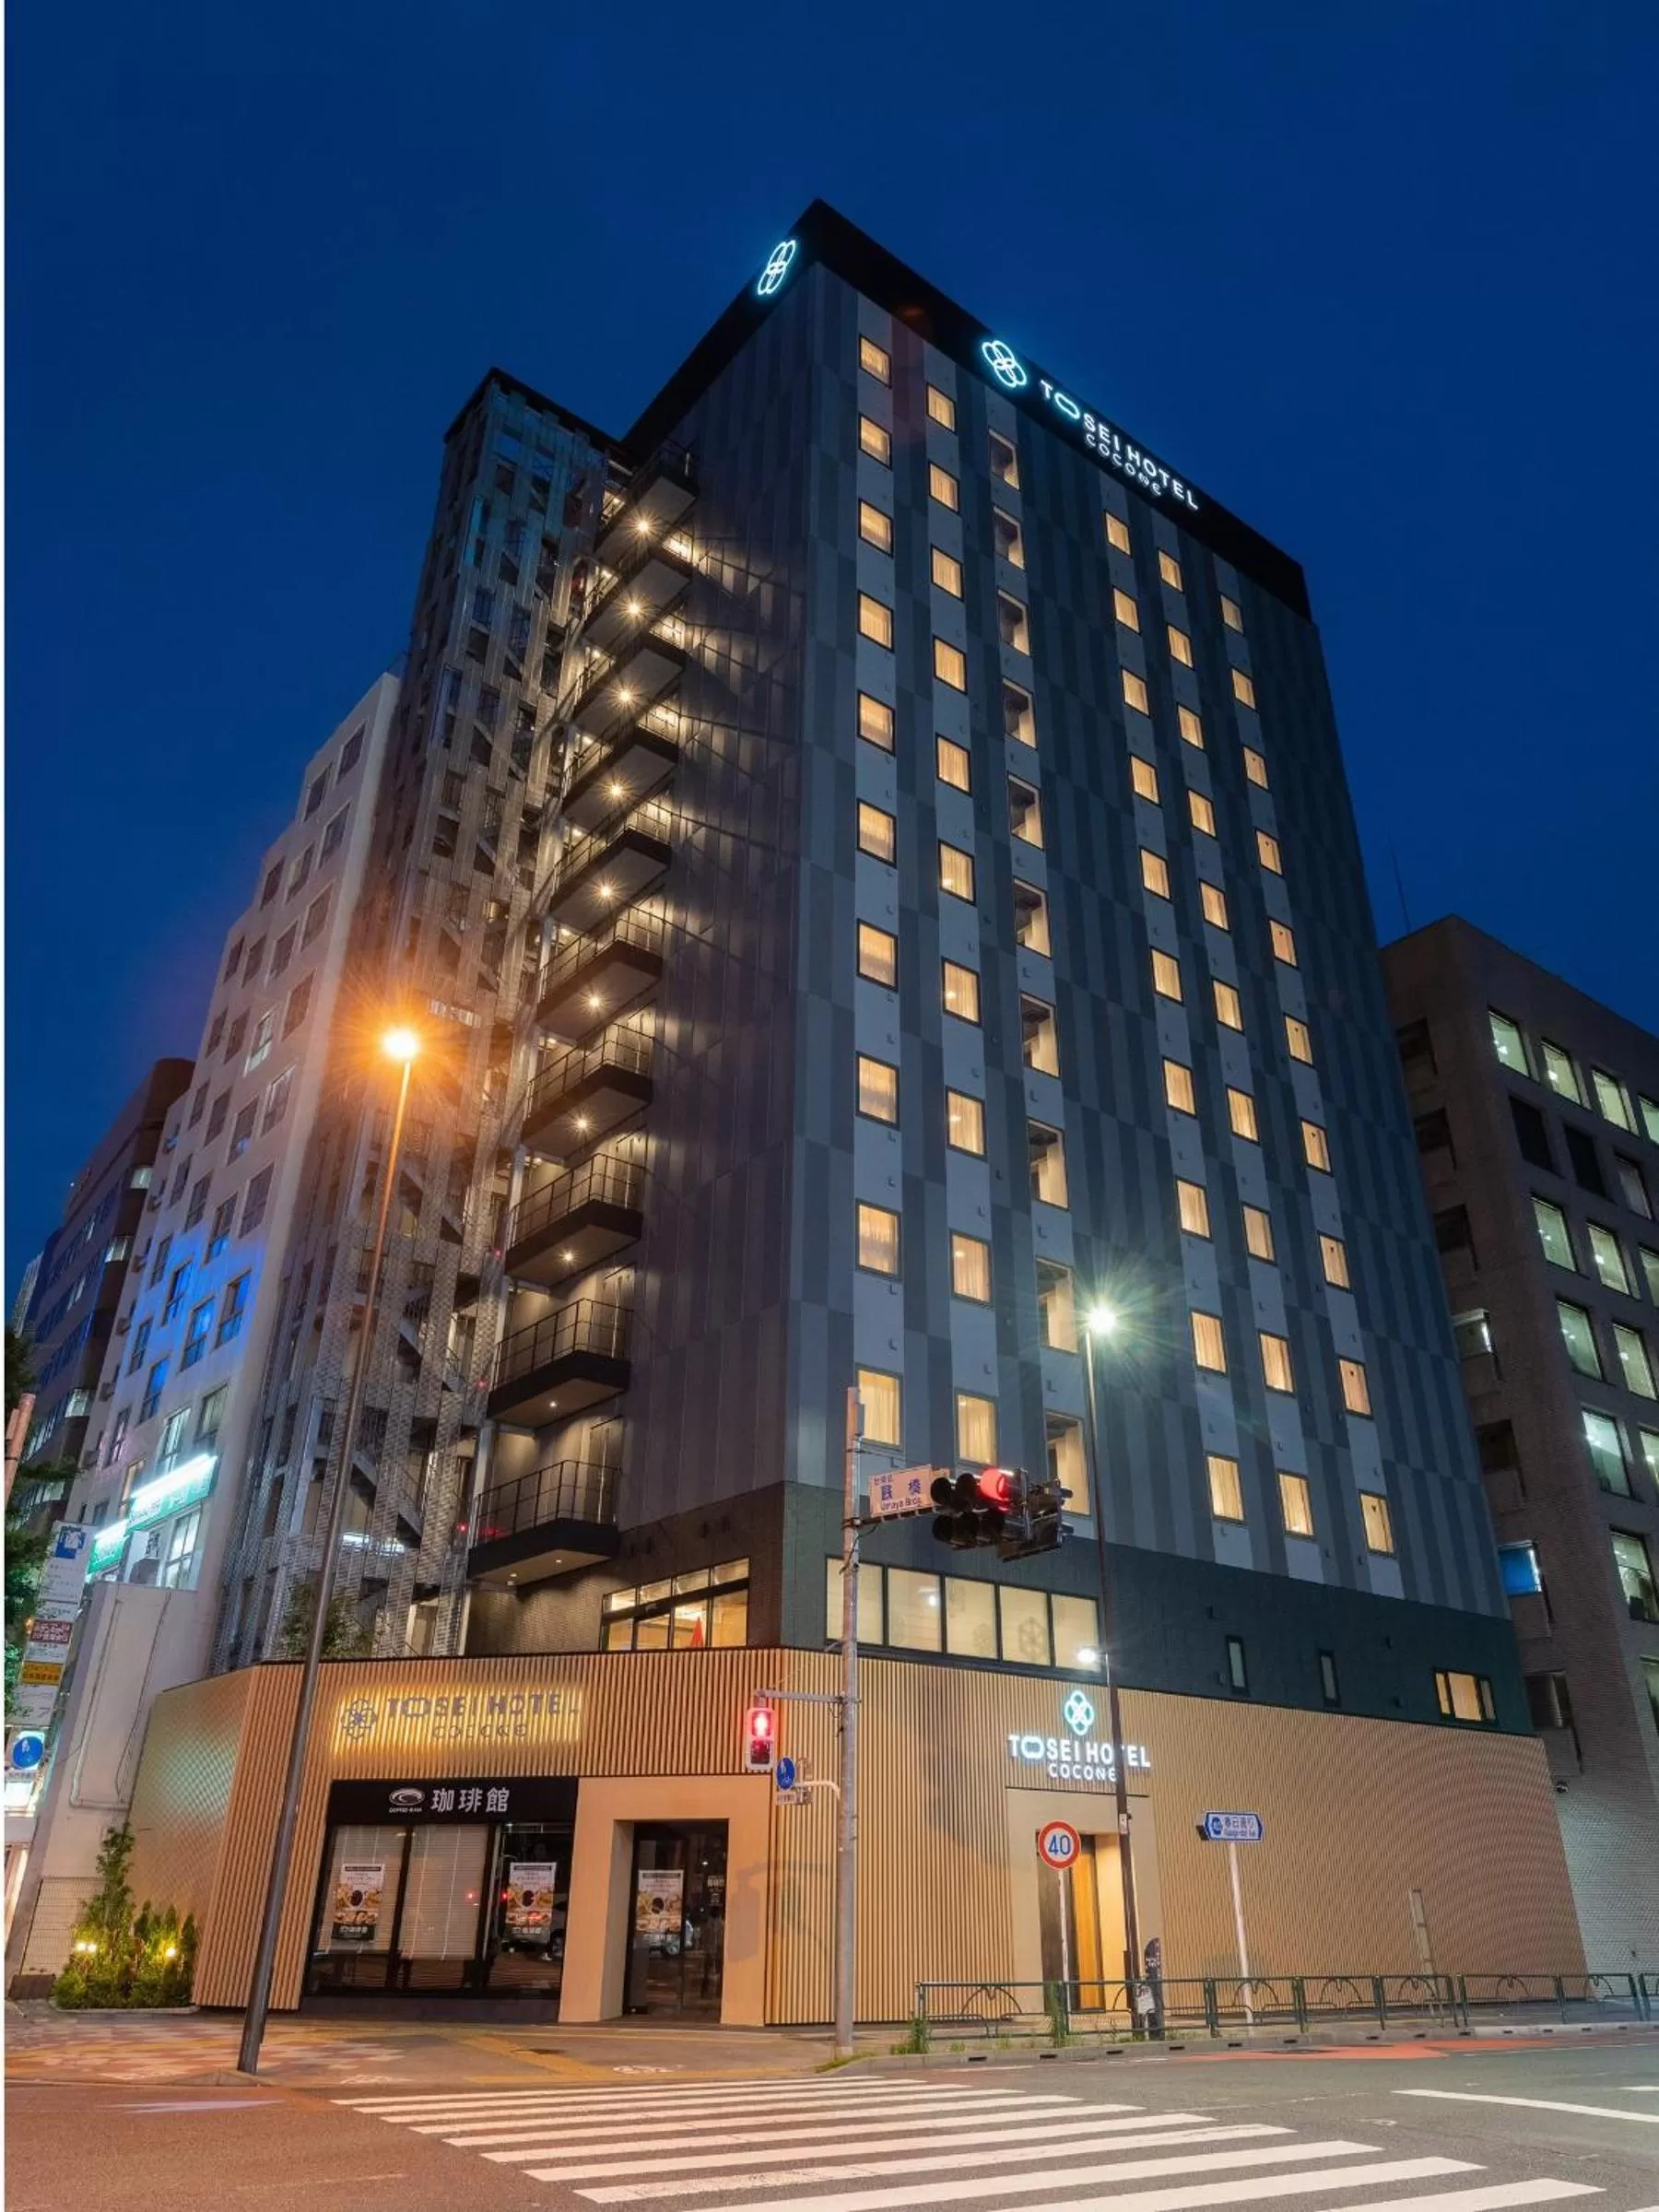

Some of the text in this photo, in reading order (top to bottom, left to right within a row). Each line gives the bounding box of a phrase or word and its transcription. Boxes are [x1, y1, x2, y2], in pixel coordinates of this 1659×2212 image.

[1040, 379, 1198, 511] TOSEI HOTEL
[1086, 434, 1162, 496] COCONE
[387, 1693, 580, 1718] TOSEI HOTEL
[1008, 1734, 1151, 1768] TOSEI HOEL
[1049, 1762, 1117, 1782] COCONE
[430, 1787, 510, 1813] 珈琲館
[1048, 1835, 1071, 1855] 40
